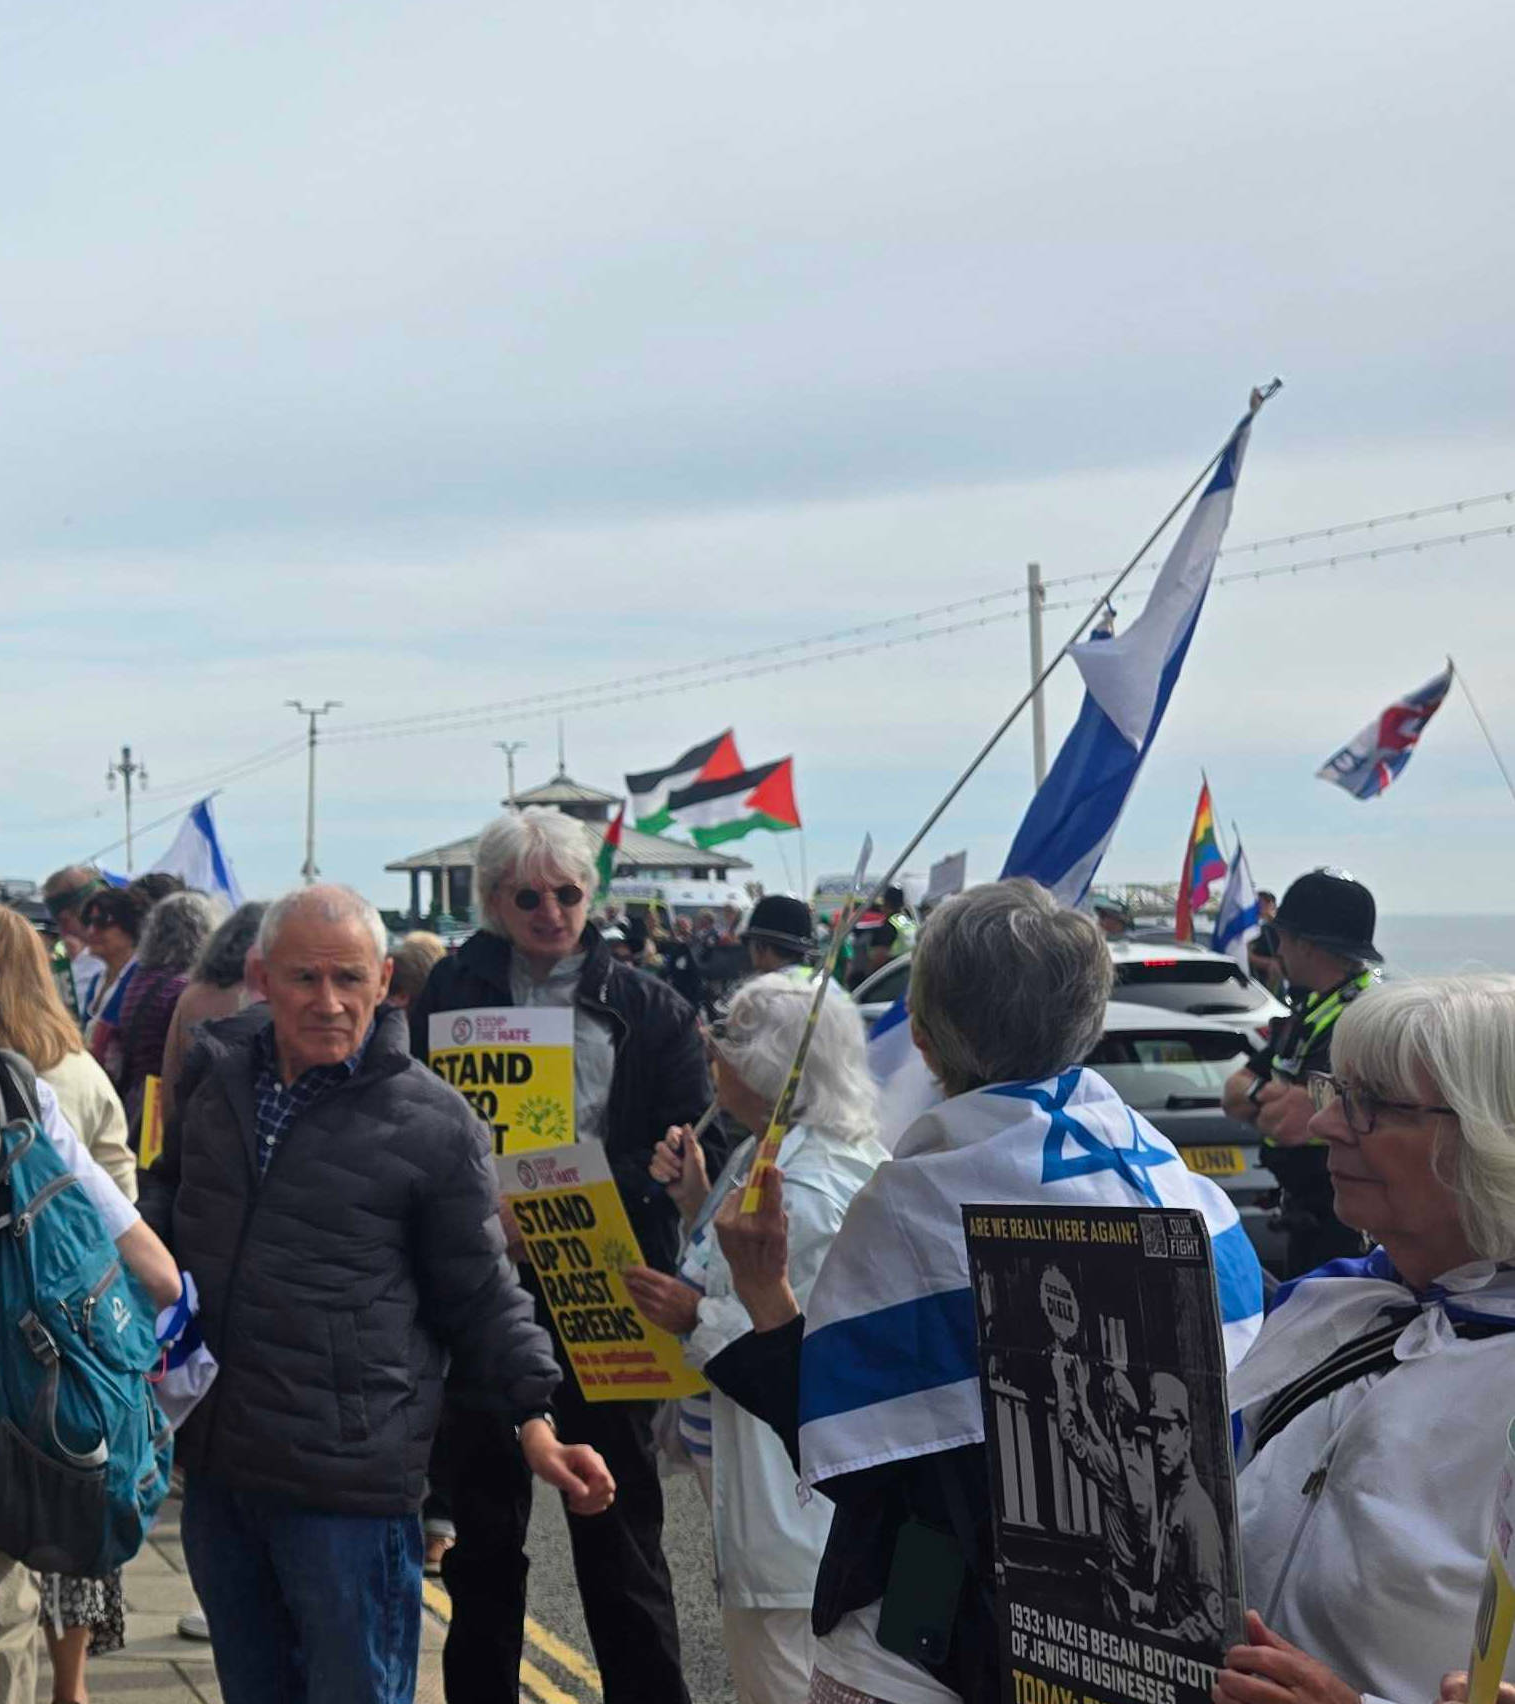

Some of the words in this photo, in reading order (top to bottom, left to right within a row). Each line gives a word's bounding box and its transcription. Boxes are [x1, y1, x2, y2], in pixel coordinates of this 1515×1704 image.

[475, 1015, 507, 1027] STOP
[475, 1029, 497, 1041] THE
[498, 1028, 531, 1042] HATE
[432, 1053, 533, 1087] STAND
[513, 1194, 596, 1235] STAND
[969, 1217, 991, 1237] ARE
[991, 1218, 1009, 1238] WE
[1009, 1218, 1052, 1240] REALLY
[1055, 1220, 1088, 1242] HERE
[1090, 1221, 1138, 1245] AGAIN?
[1169, 1218, 1193, 1235] OUR
[529, 1239, 559, 1271] UP
[557, 1236, 593, 1269] TO
[1170, 1239, 1201, 1256] FIGHT
[542, 1270, 615, 1307] RACIST
[557, 1306, 645, 1343] GREENS
[1010, 1602, 1044, 1637] 1933:
[1046, 1613, 1088, 1651] NAZIS
[1090, 1628, 1140, 1669] BEGAN
[1011, 1630, 1027, 1659] OF
[1029, 1638, 1079, 1679] JEWISH
[1082, 1655, 1176, 1704] BUSINESSES
